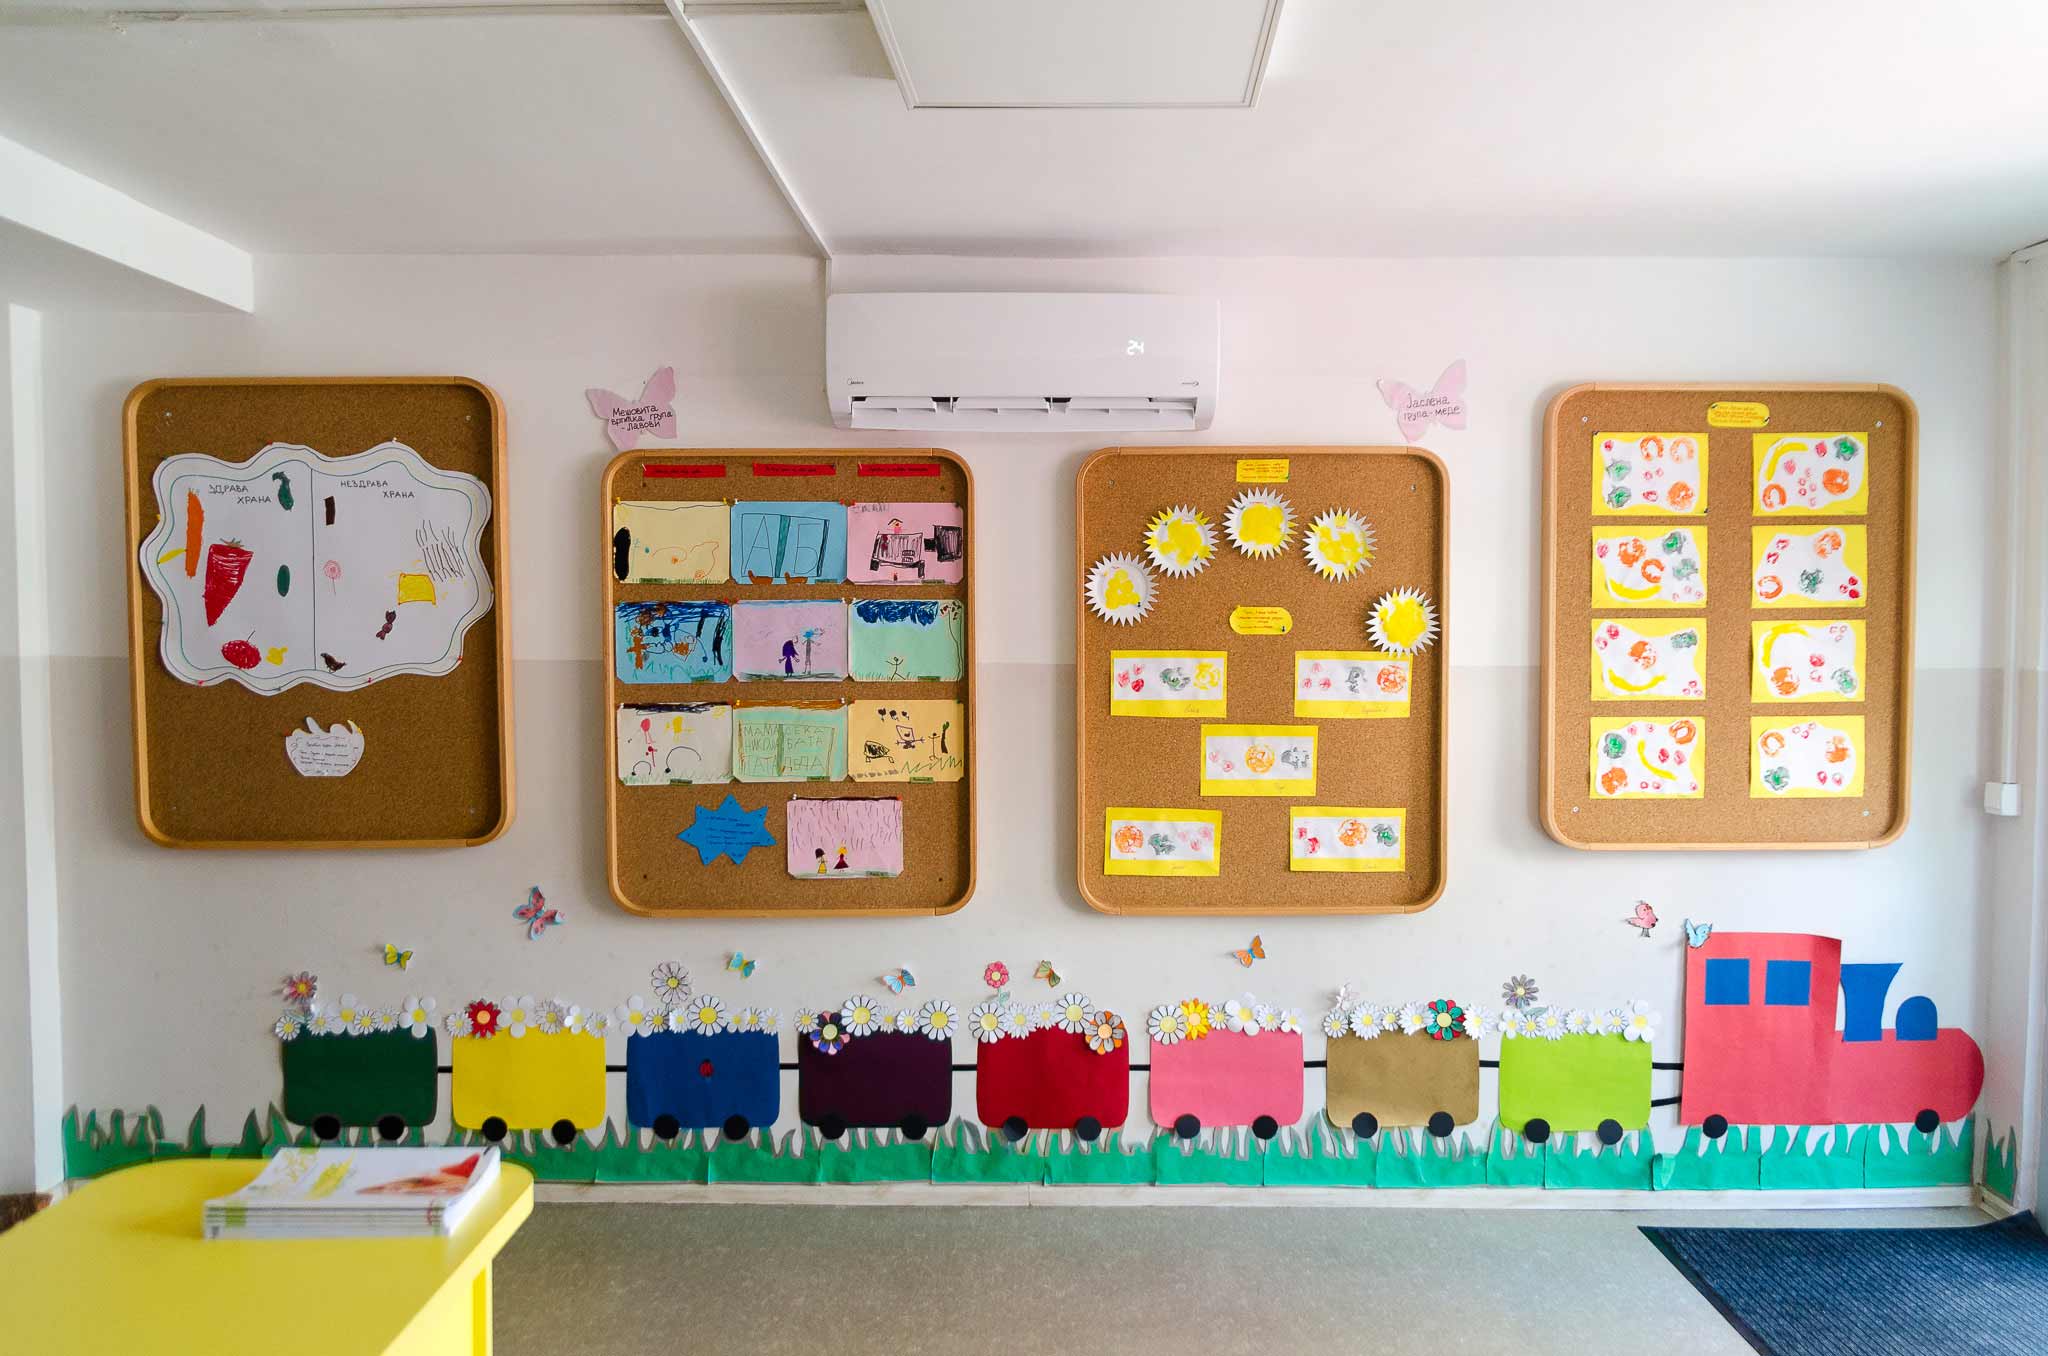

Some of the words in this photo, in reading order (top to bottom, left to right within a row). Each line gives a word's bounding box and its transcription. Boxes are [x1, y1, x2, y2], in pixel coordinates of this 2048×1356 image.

[1126, 339, 1145, 355] 24
[208, 484, 249, 496] ЗДРАВА
[383, 489, 415, 499] ХРАНА
[236, 495, 272, 505] ХРАНА
